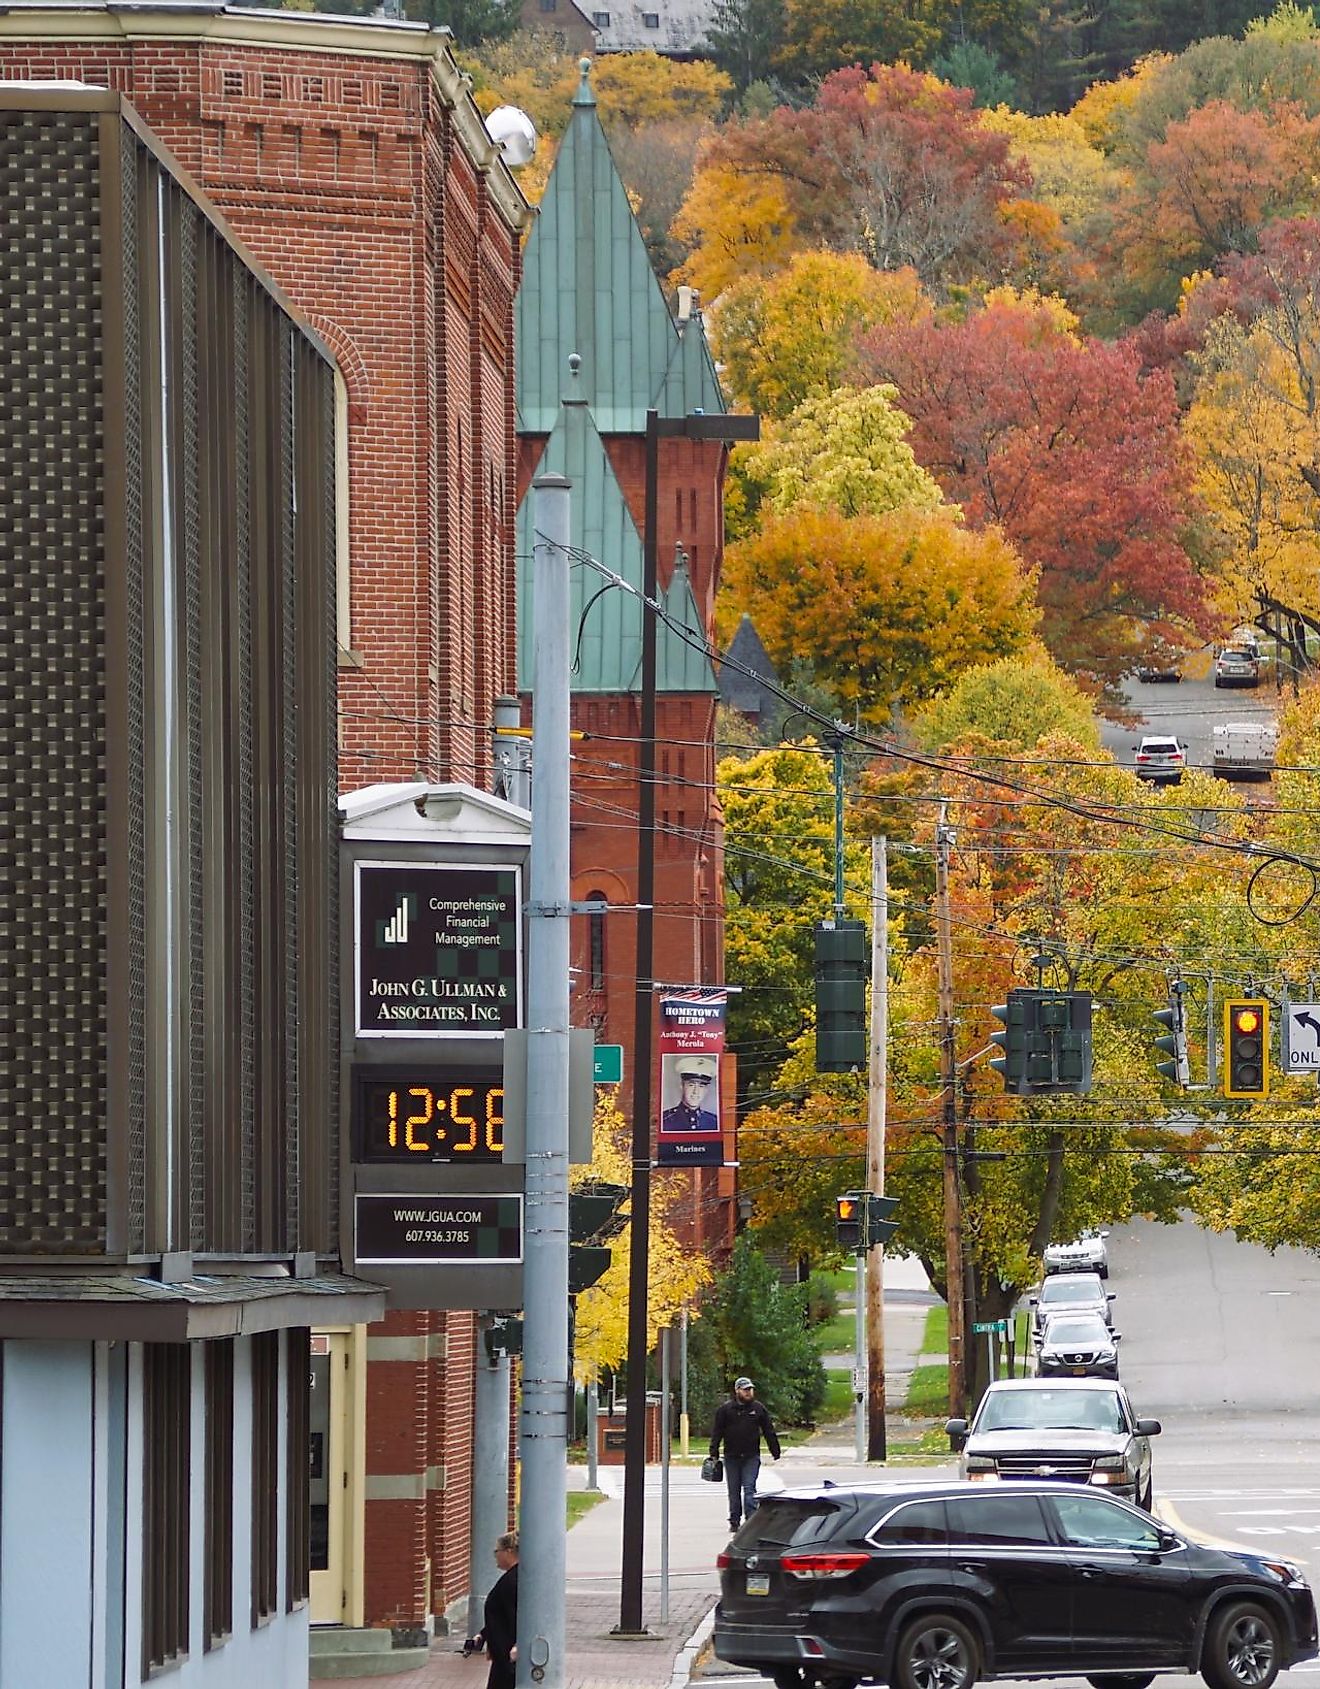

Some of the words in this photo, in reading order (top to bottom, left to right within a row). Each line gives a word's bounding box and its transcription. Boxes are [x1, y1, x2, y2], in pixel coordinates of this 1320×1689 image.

[429, 898, 506, 913] Comprehensive
[446, 915, 489, 928] Financial
[435, 932, 501, 947] Management
[369, 979, 409, 996] JOHN
[411, 979, 428, 996] G.
[431, 979, 495, 997] ULLMAN
[498, 984, 507, 997] &
[377, 1003, 468, 1021] ASSOCIATES,
[470, 1003, 501, 1020] INC.
[665, 1007, 720, 1017] HOMETOWN
[677, 1016, 705, 1025] HERO
[661, 1031, 689, 1039] Anthony
[393, 1210, 481, 1223] WWW.JGUA.COM
[405, 1230, 469, 1242] 607.936.3785
